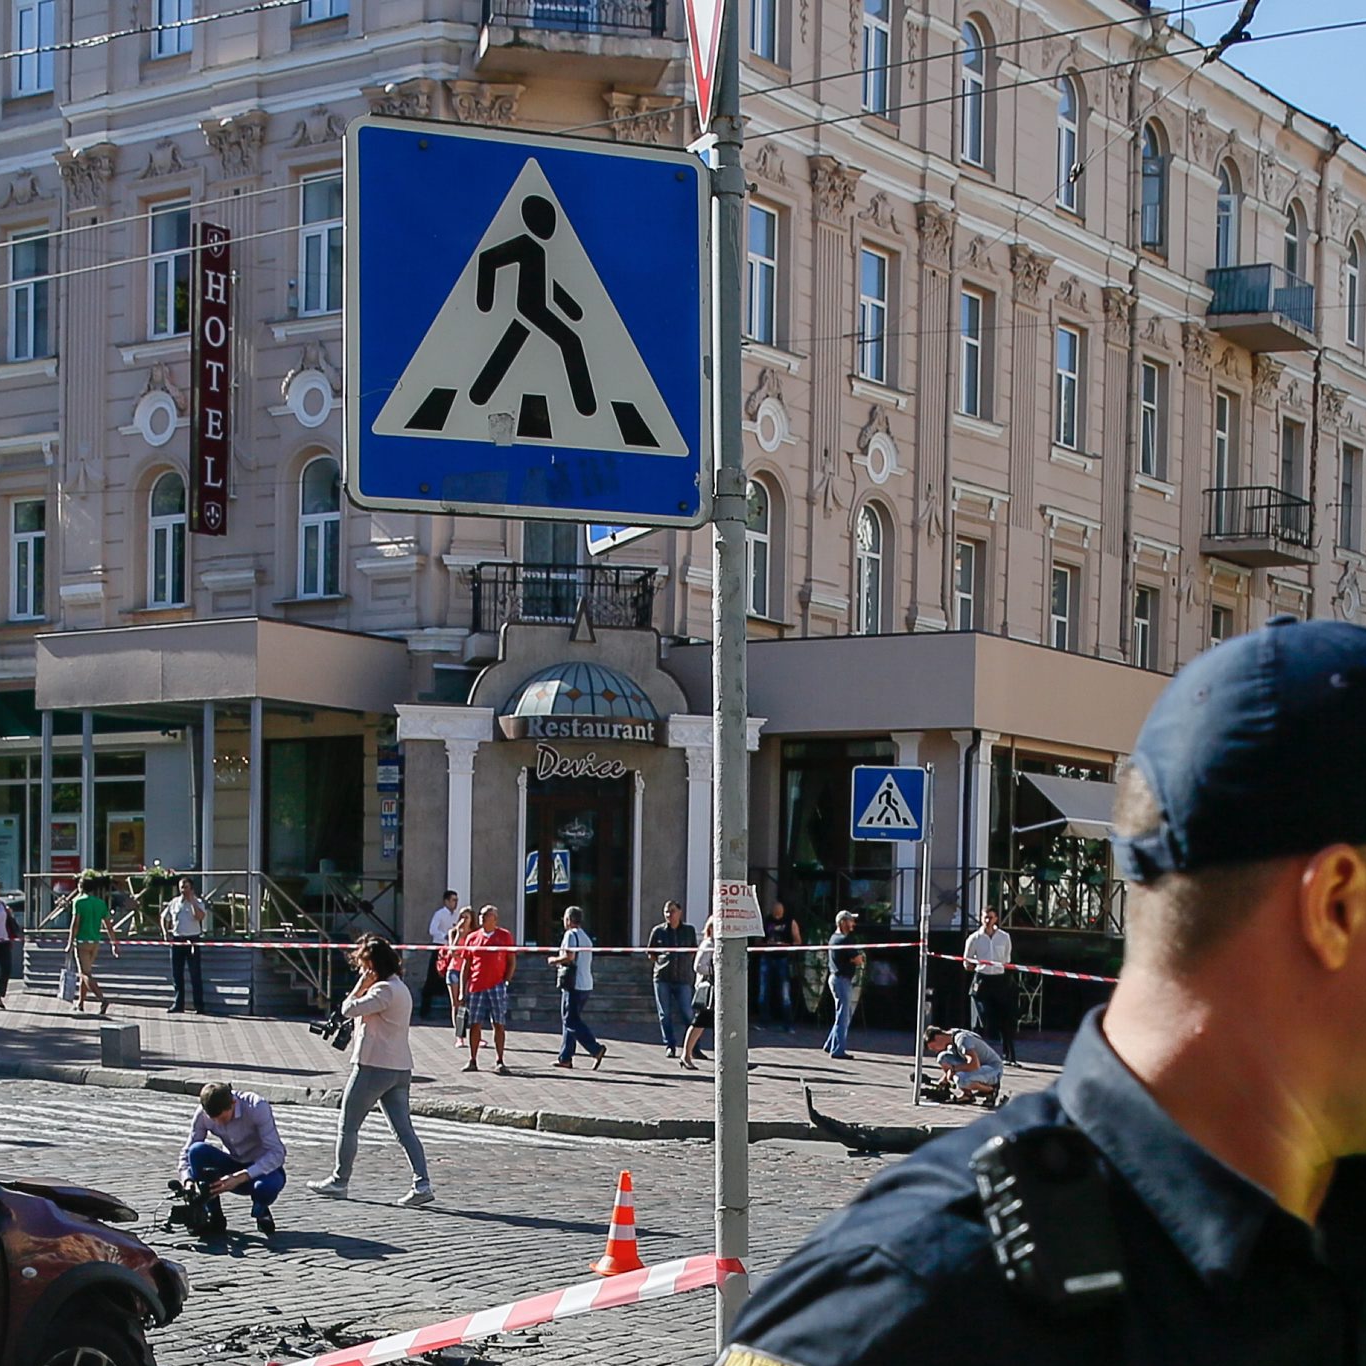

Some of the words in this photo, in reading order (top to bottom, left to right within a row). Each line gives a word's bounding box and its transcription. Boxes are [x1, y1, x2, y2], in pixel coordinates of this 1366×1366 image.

[204, 270, 227, 488] HOTEL
[527, 716, 655, 742] Restaurant
[536, 743, 627, 780] Device
